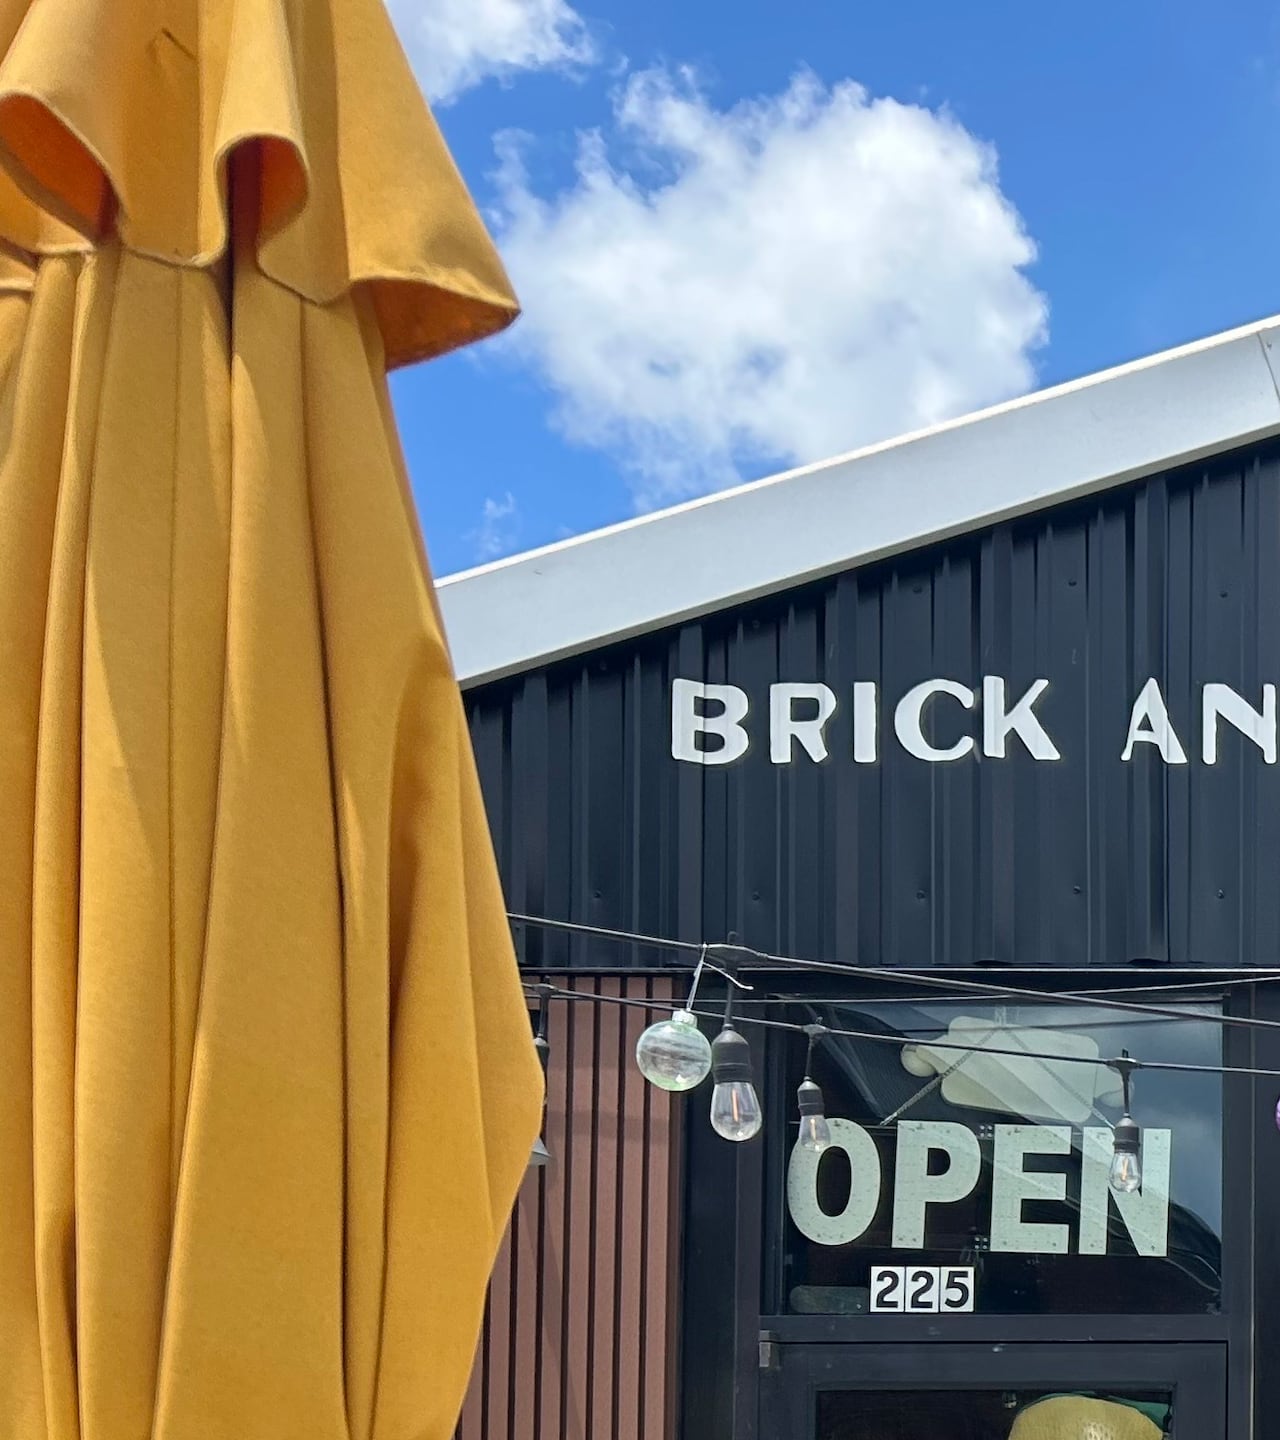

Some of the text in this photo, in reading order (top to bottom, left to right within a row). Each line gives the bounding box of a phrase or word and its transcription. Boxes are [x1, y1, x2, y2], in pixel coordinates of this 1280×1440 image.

[671, 675, 1061, 765] BRICK
[787, 1117, 1172, 1257] OPEN
[875, 1269, 969, 1309] 225
